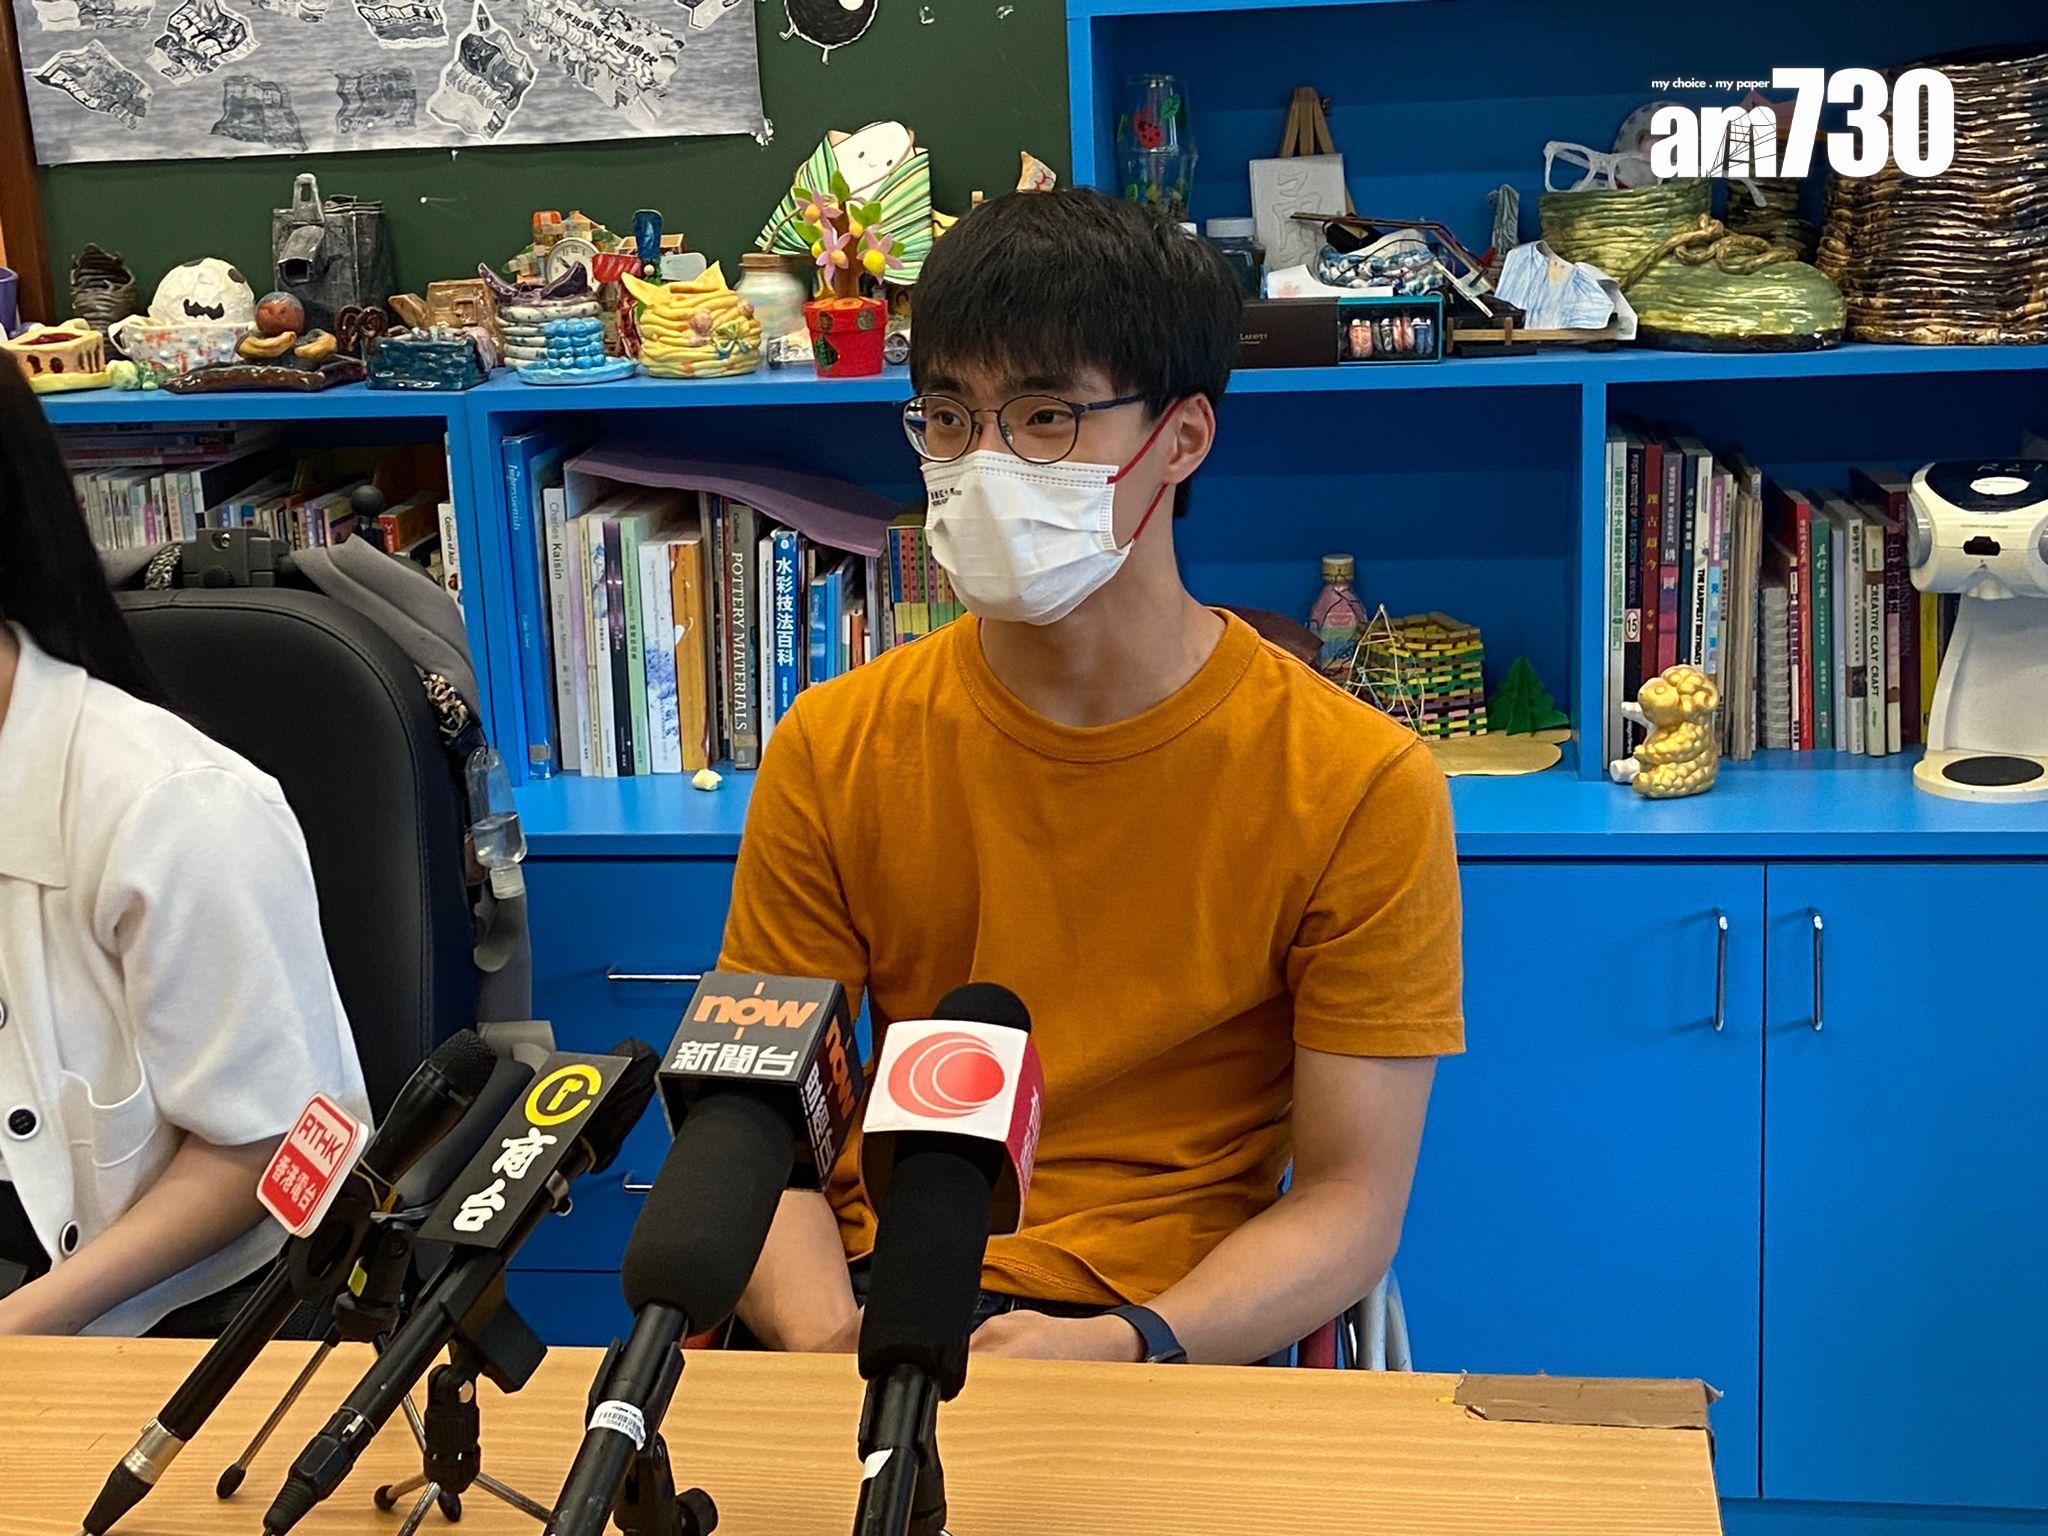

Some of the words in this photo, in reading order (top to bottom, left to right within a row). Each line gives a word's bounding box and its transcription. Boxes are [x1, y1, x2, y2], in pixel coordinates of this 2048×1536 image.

[549, 502, 562, 541] Charles
[552, 543, 564, 580] Kaisin
[731, 552, 745, 628] POTTERY
[776, 557, 794, 667] 水彩技法百科
[1870, 583, 1880, 632] CREATIVE
[1627, 619, 1637, 632] 15
[1870, 635, 1880, 661] CLAY
[732, 633, 747, 731] MATERIALS
[1871, 665, 1881, 697] CRAFT
[693, 994, 820, 1029] now
[671, 1040, 799, 1077] 新聞台
[825, 1015, 856, 1121] now
[298, 1113, 344, 1165] RTHK
[271, 1155, 318, 1212] 香港電台
[453, 1127, 558, 1232] 商台
